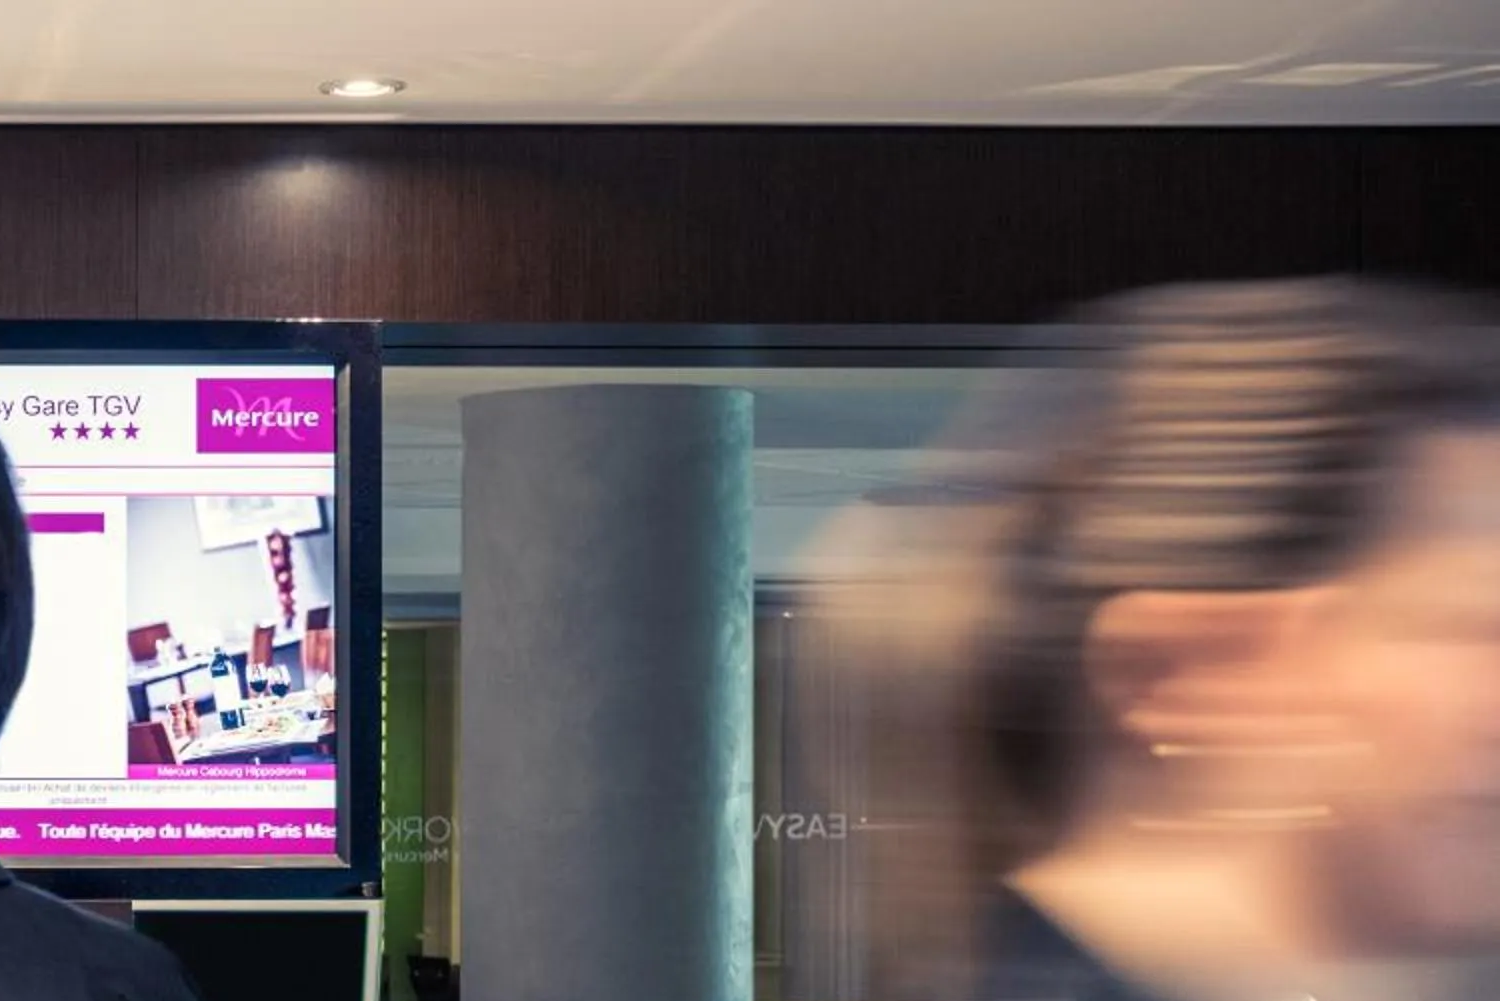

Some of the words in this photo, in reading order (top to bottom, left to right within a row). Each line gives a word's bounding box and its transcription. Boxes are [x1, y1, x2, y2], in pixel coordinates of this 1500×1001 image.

[22, 395, 79, 417] Gare
[87, 395, 142, 417] TGV
[211, 408, 320, 428] Mercure
[37, 823, 87, 839] Toute
[89, 823, 156, 842] l'équipe
[158, 823, 182, 839] du
[185, 823, 255, 839] Mercure
[258, 823, 303, 839] Paris
